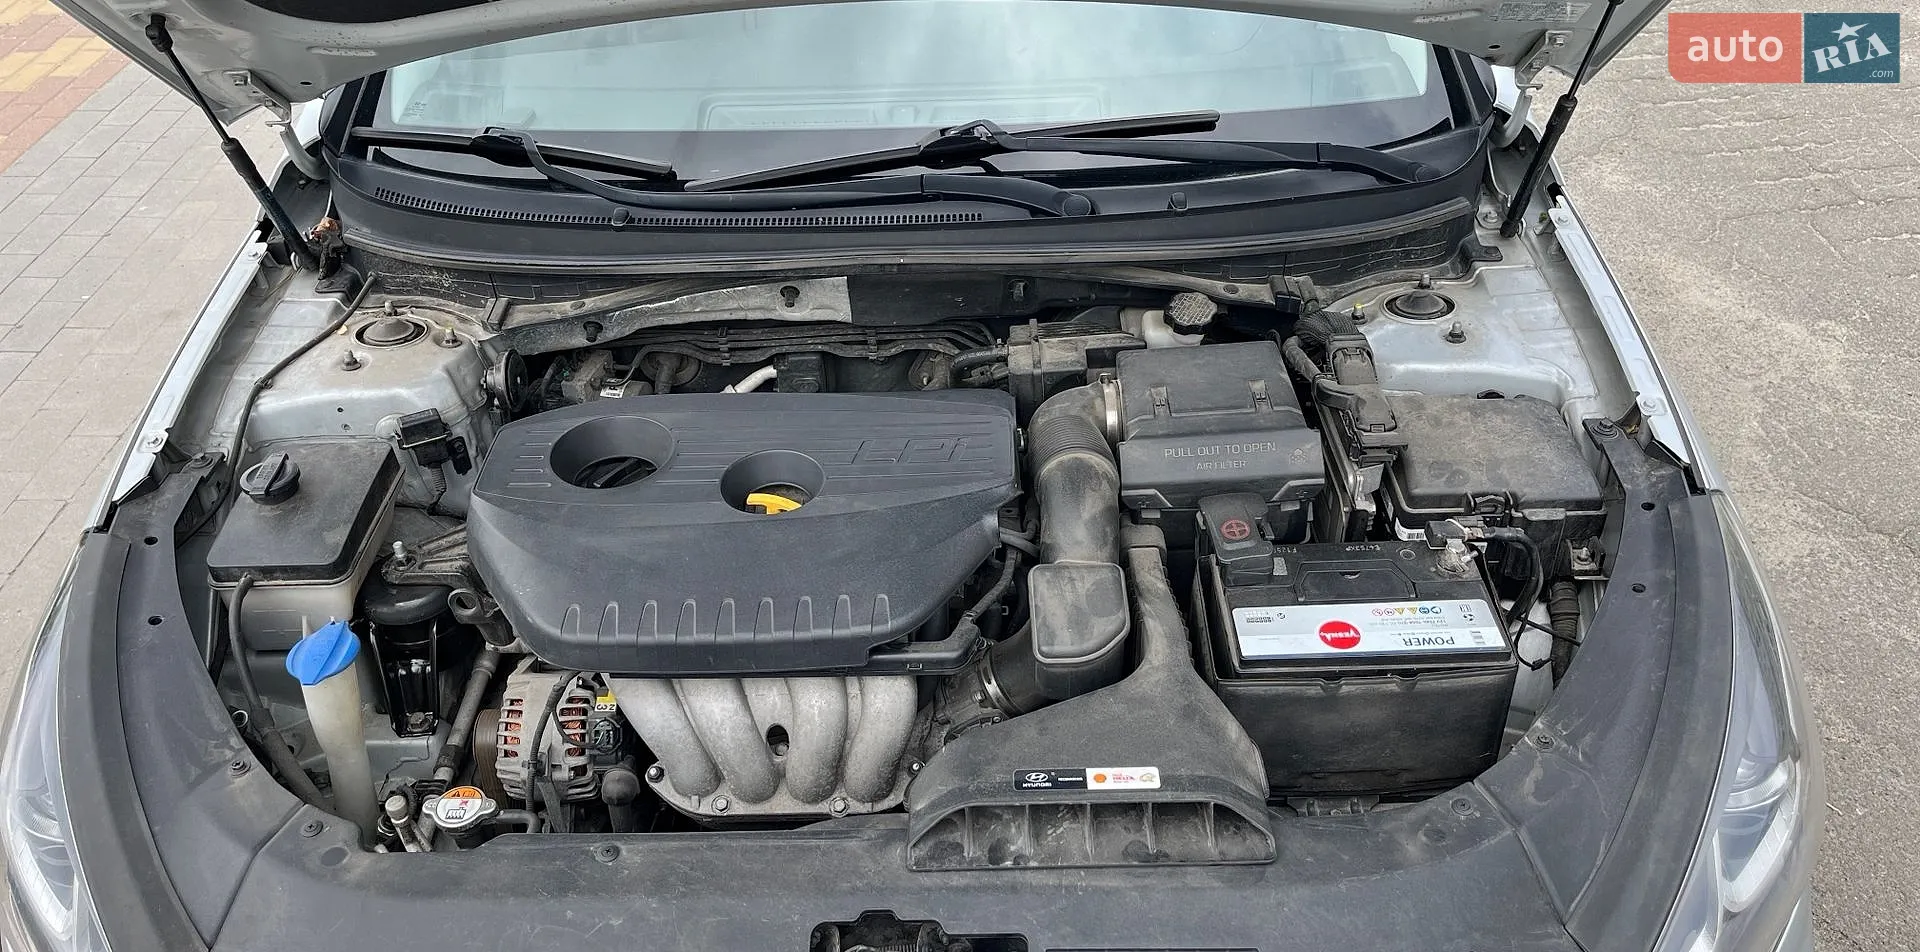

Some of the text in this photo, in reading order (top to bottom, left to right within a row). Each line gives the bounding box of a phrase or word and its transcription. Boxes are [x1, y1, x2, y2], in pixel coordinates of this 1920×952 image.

[1164, 441, 1276, 459] PULL OUT TO OPEN
[1196, 459, 1246, 471] AIR FILTER
[1402, 636, 1455, 647] POWER
